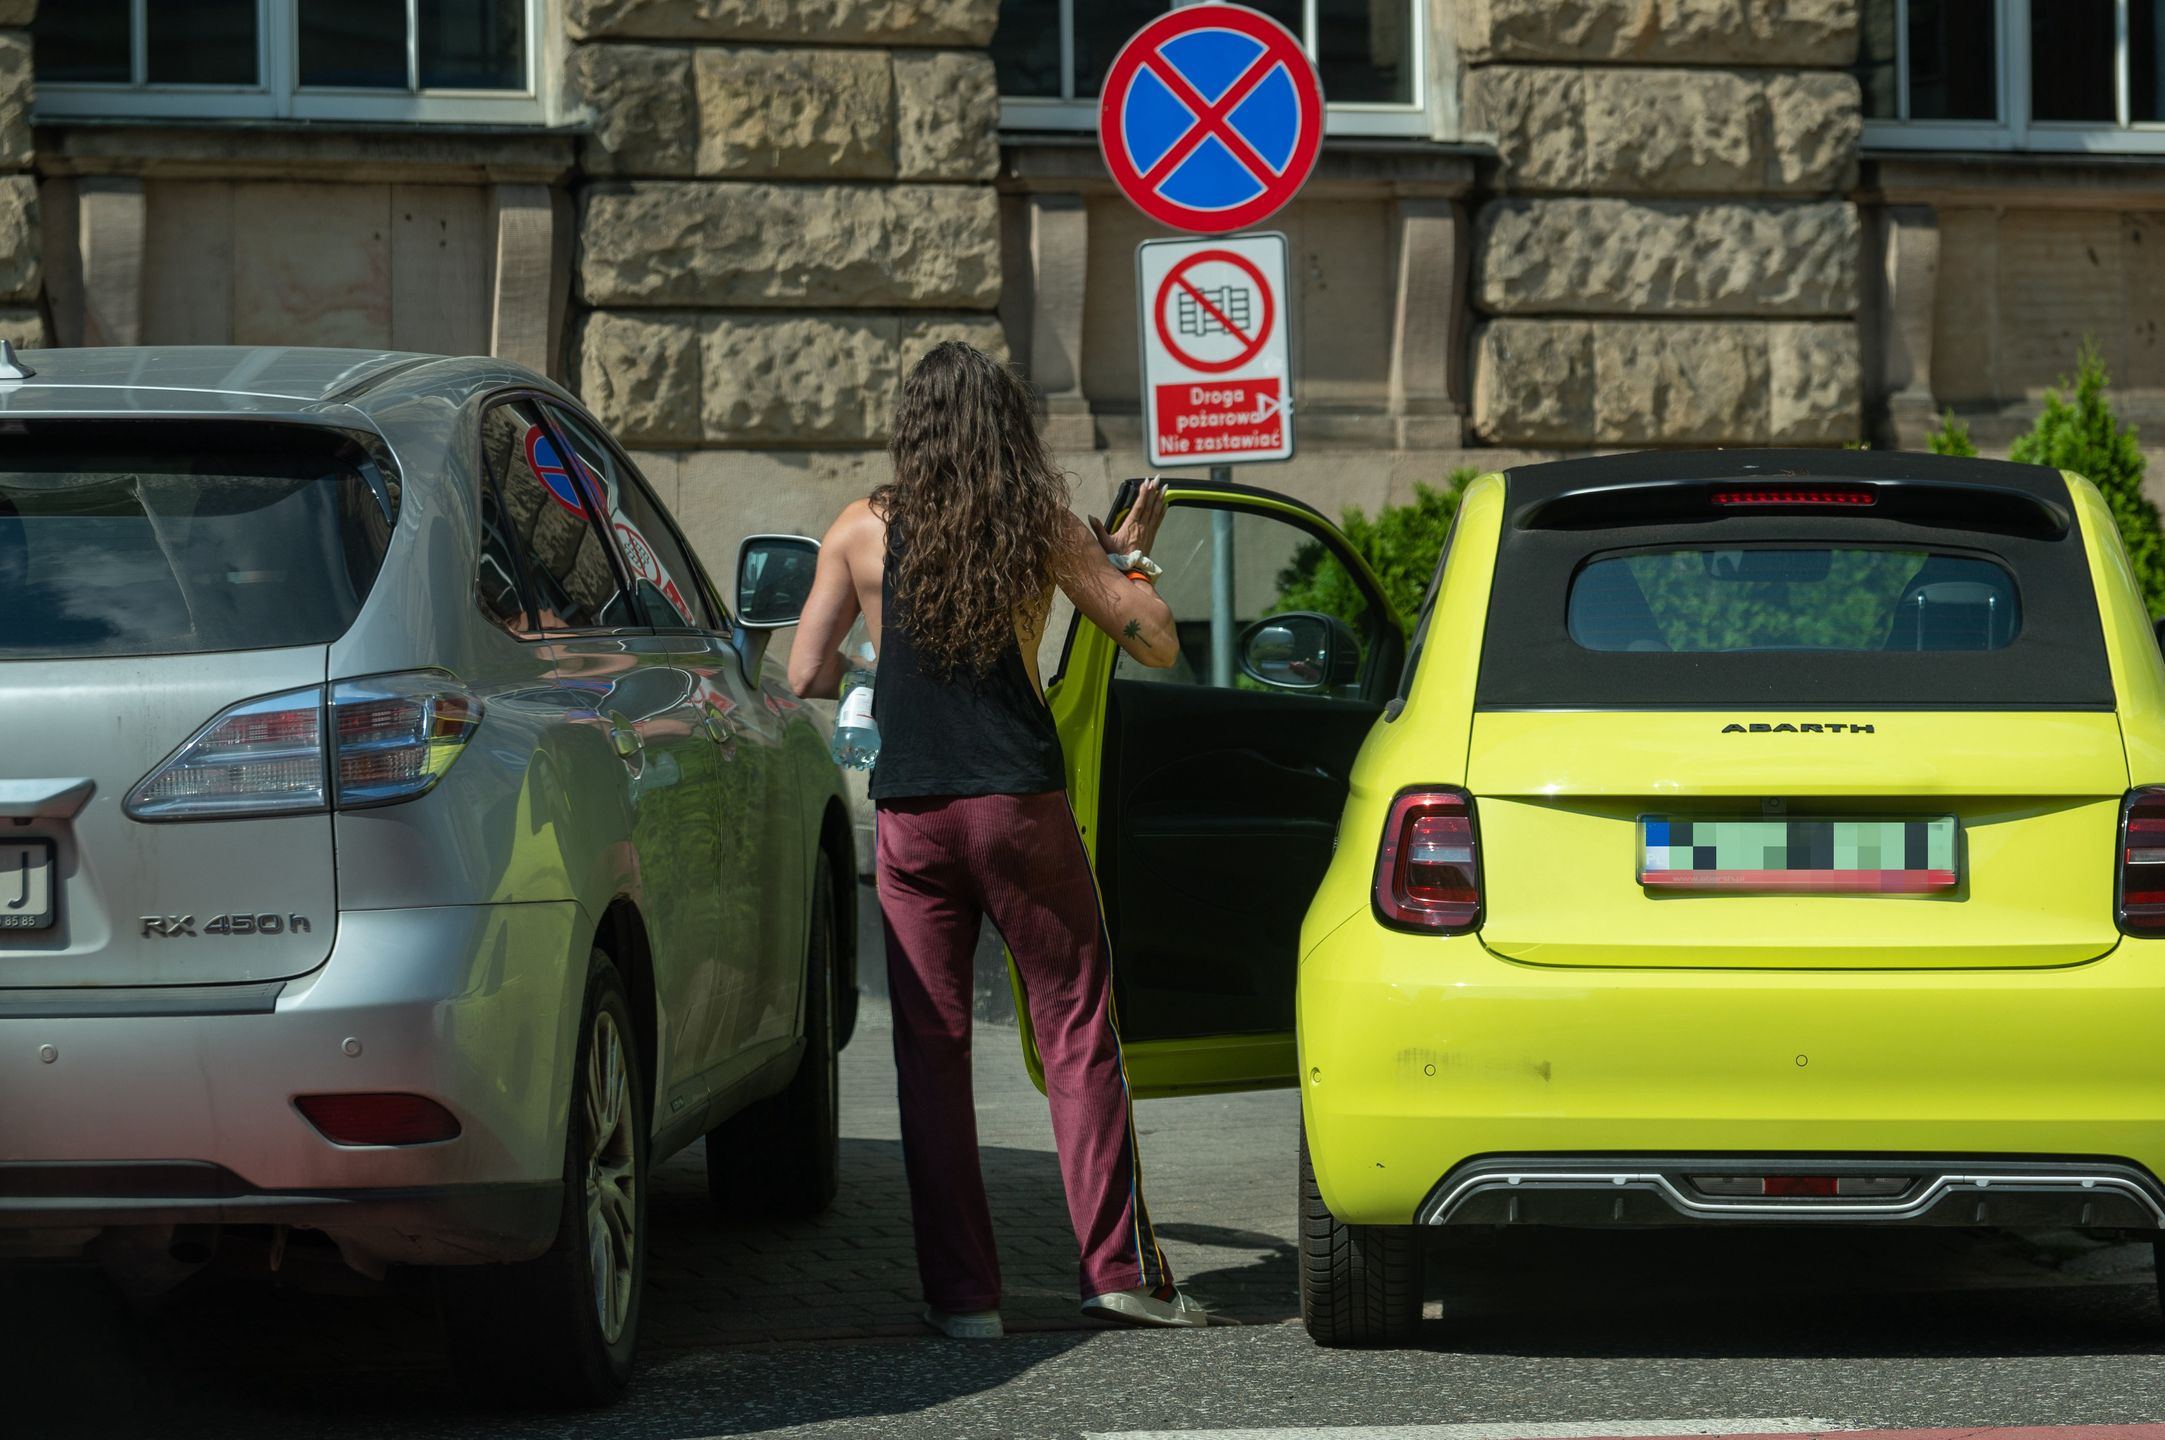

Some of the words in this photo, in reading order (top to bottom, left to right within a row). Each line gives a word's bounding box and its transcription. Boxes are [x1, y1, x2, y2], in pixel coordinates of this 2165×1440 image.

[1189, 386, 1245, 408] Droga
[1159, 433, 1190, 453] Nie
[1194, 428, 1282, 451] zastawiać
[1721, 722, 1875, 734] ABARTH
[138, 913, 198, 940] RX
